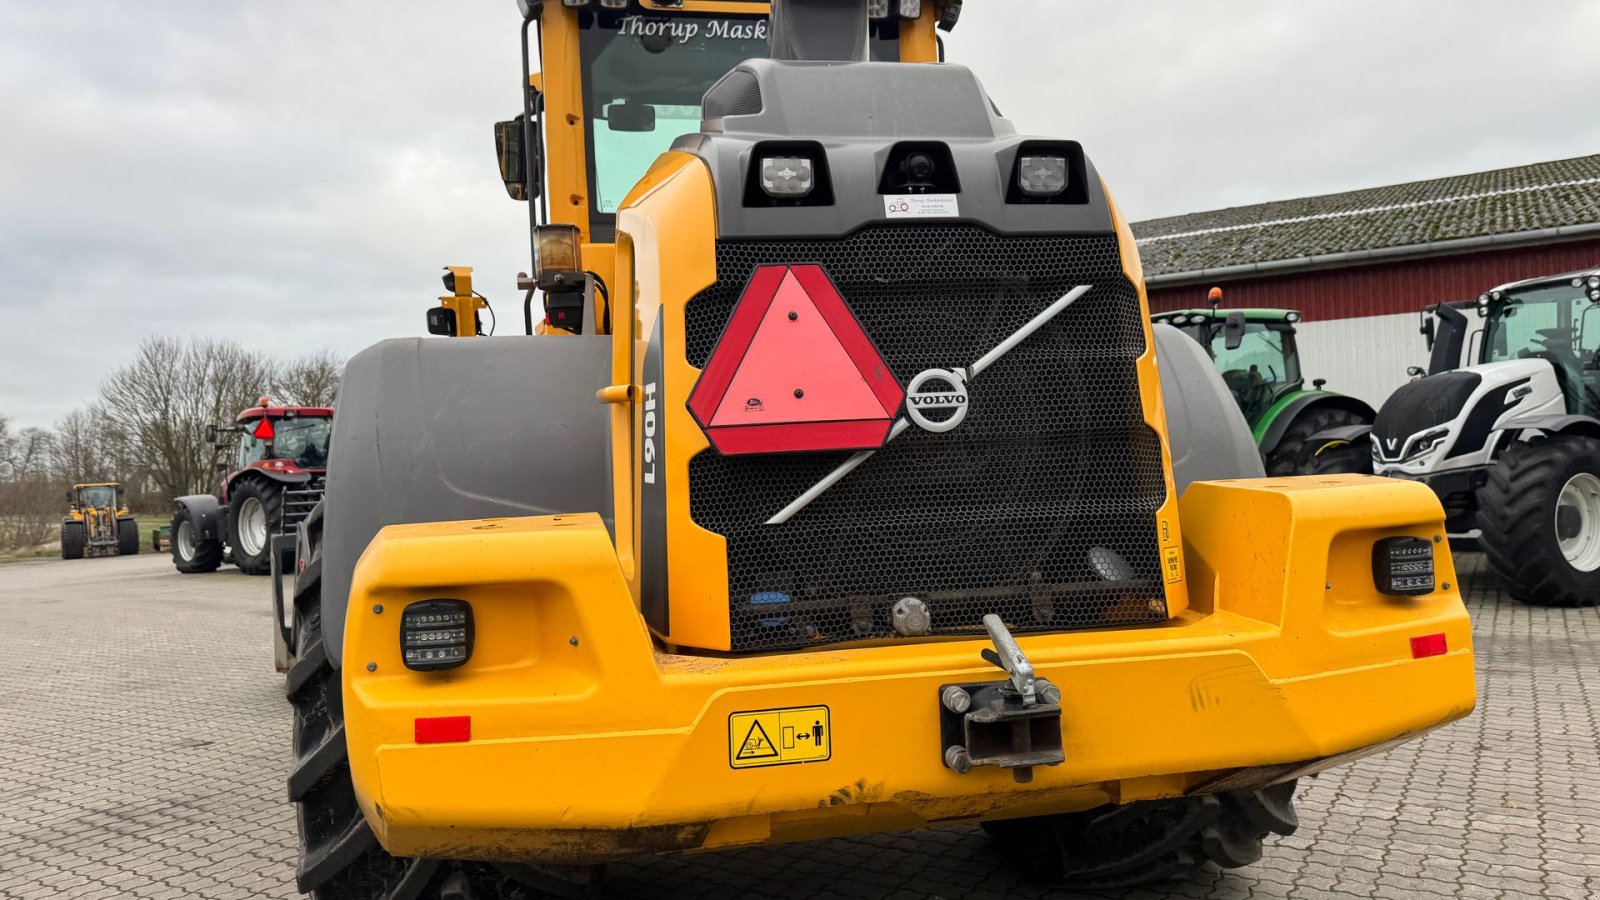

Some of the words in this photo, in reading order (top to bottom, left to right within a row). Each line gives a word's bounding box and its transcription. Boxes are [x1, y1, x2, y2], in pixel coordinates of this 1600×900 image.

[615, 15, 698, 43] Thorup
[909, 394, 966, 406] VOLVO
[644, 382, 656, 484] L90H
